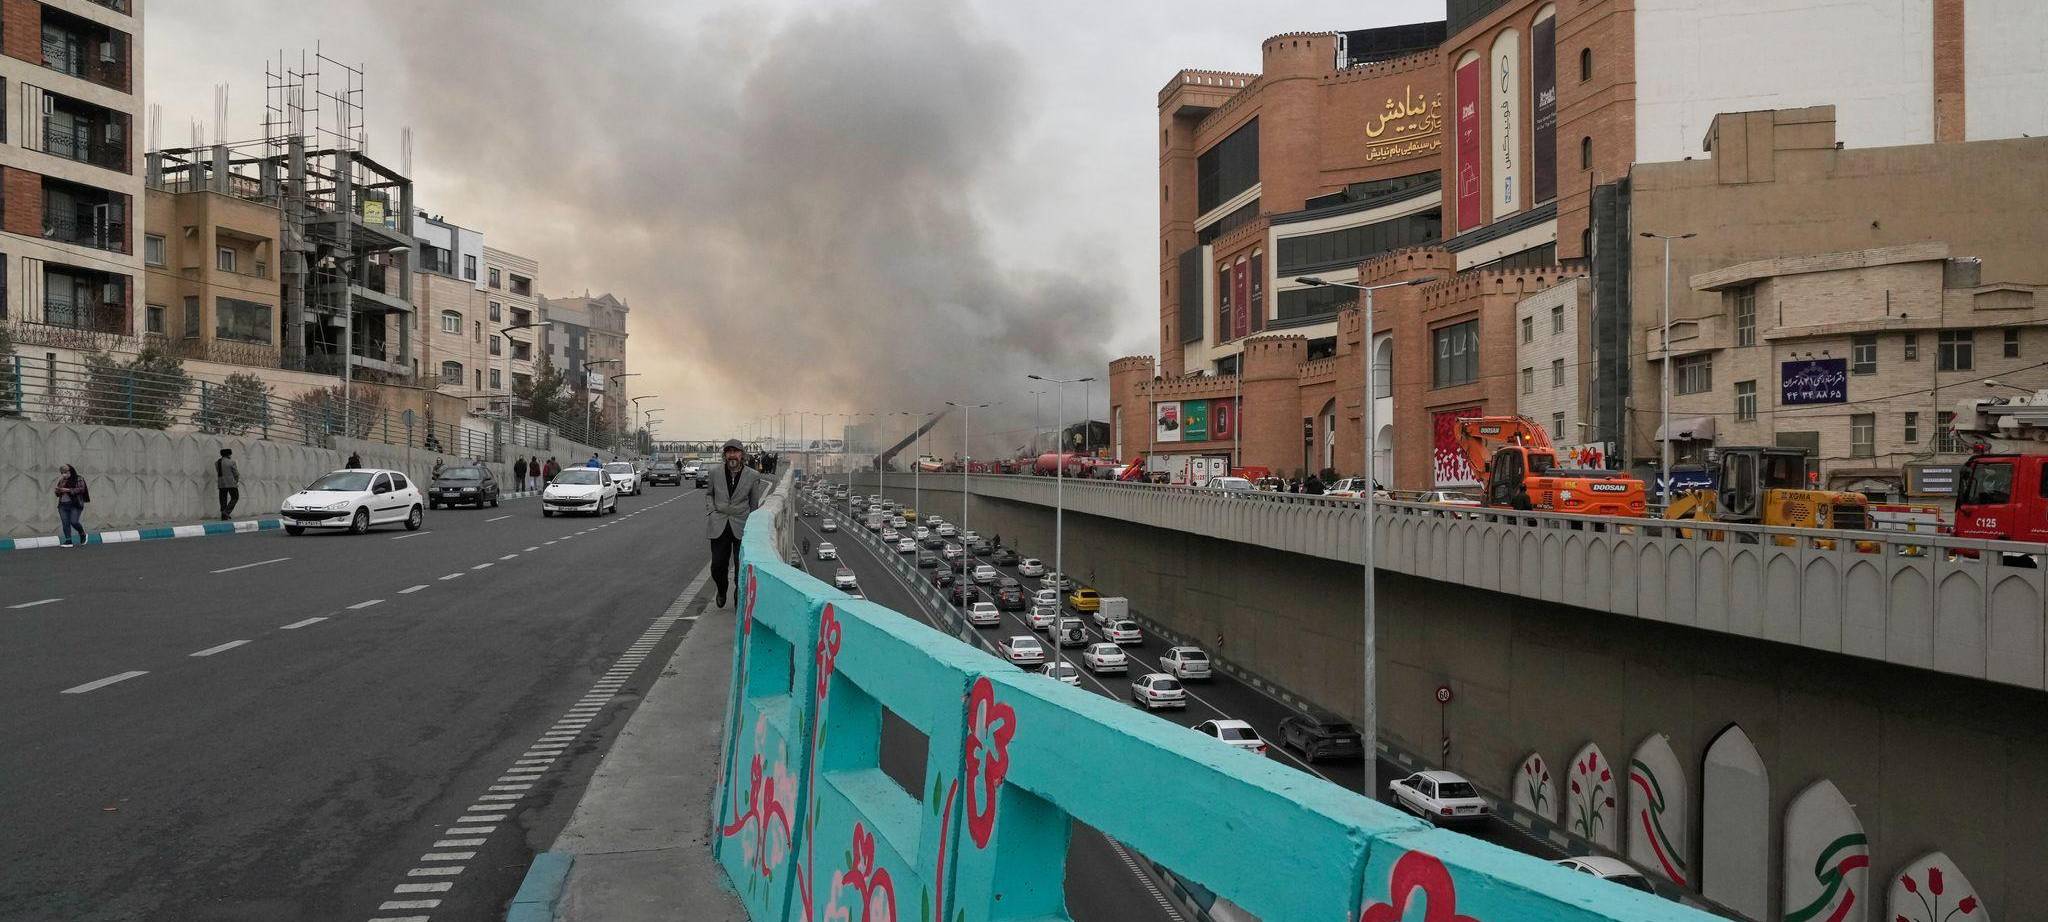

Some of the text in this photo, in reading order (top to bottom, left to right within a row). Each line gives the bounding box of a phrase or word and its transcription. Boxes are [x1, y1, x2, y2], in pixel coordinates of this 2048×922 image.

[1366, 84, 1427, 137] نیایش
[1366, 147, 1390, 161] نیایش
[1390, 144, 1401, 157] بام
[1400, 141, 1430, 155] سینمایی
[1783, 375, 1799, 388] تهران
[1831, 371, 1845, 387] دفتر
[1976, 518, 1997, 528] C125
